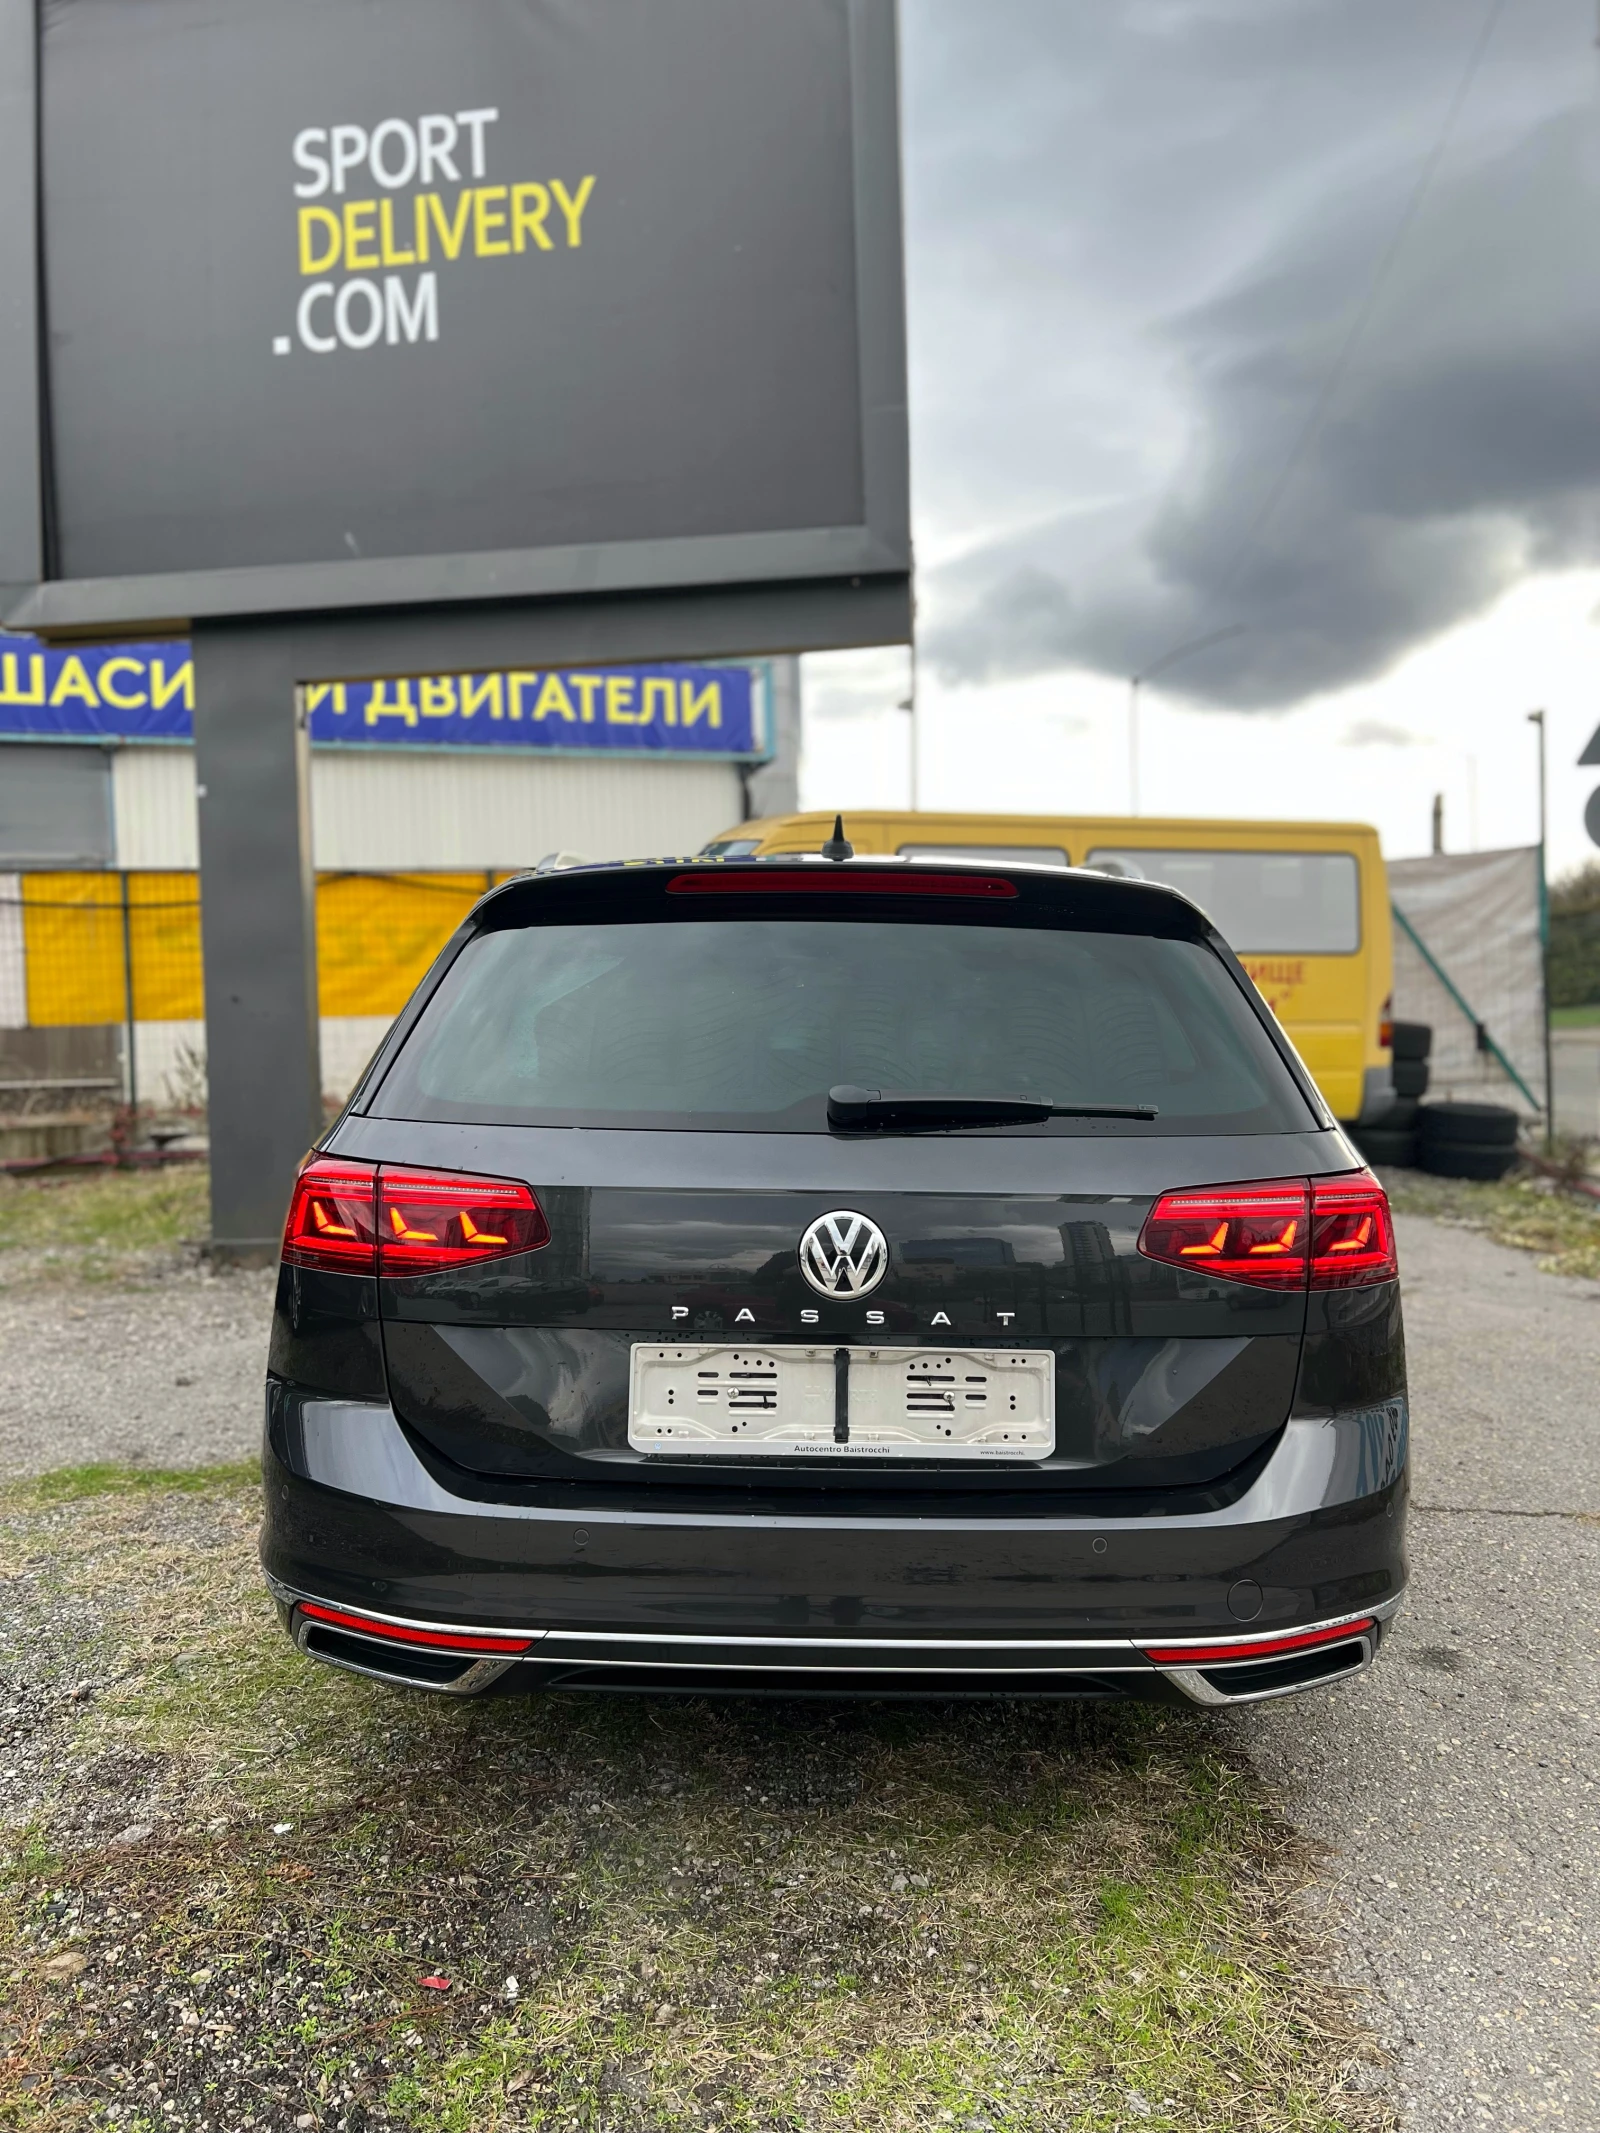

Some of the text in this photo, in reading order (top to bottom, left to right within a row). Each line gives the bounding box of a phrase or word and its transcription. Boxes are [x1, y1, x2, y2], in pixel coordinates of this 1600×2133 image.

[293, 107, 498, 198] SPORT
[298, 175, 596, 275] DELIVERY
[273, 272, 439, 355] .COM
[364, 672, 723, 728] ДВИГАТЕЛИ
[671, 1306, 1015, 1326] PASSAT
[794, 1445, 890, 1455] Autocentro Baistrocchi
